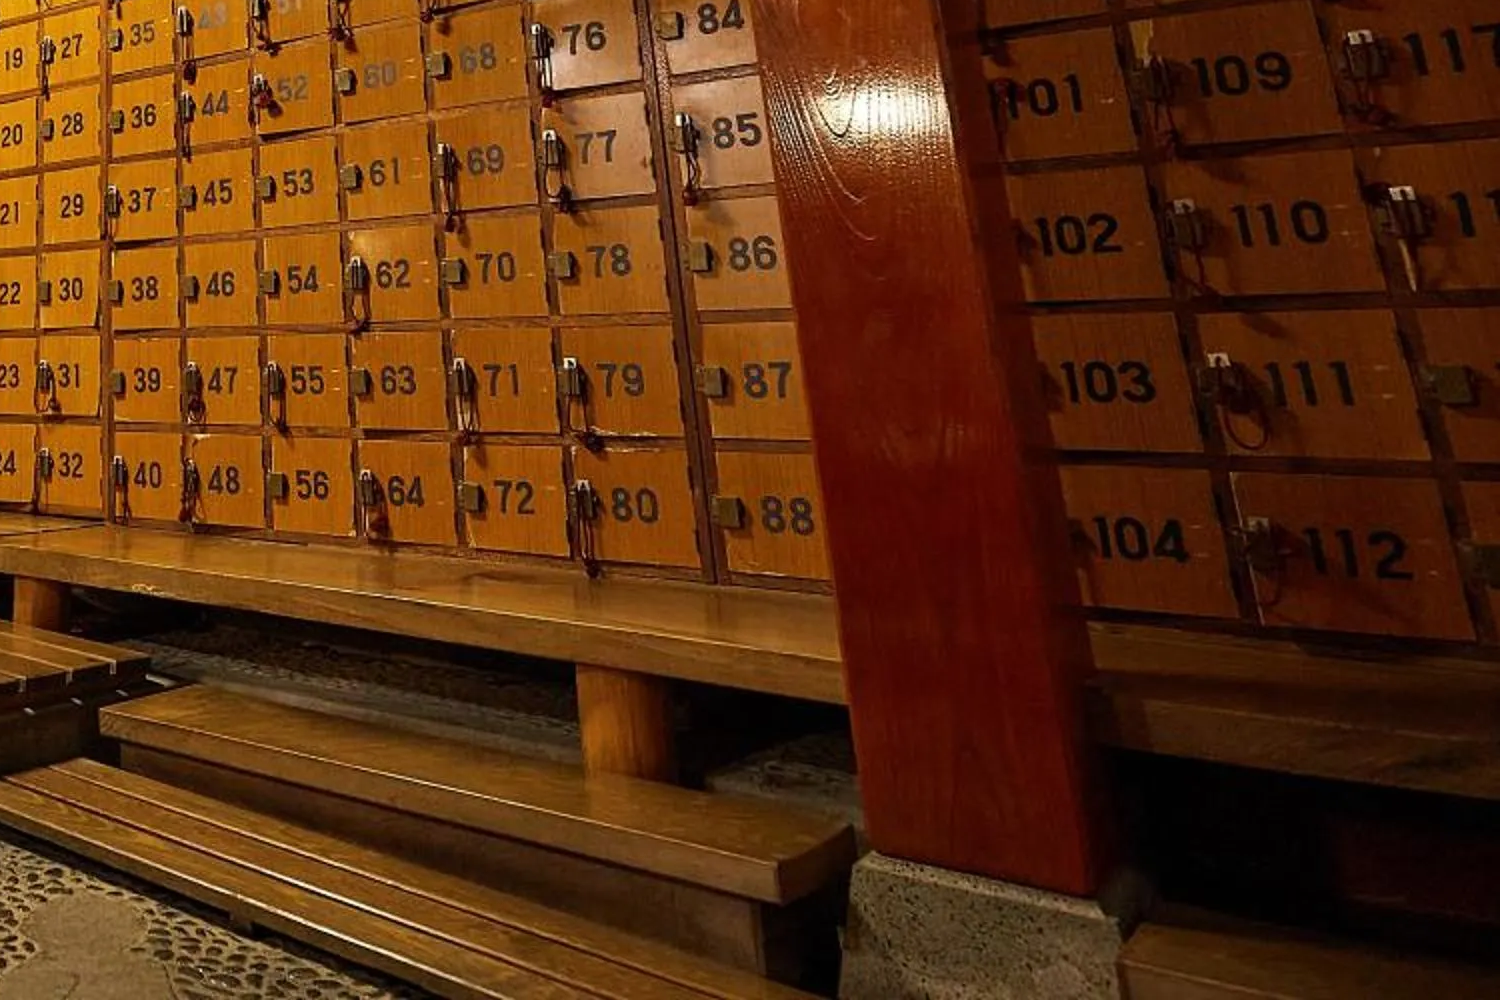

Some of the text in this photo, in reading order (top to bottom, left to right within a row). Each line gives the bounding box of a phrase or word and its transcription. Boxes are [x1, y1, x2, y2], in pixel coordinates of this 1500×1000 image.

[60, 34, 83, 59] 27
[129, 20, 155, 45] 35
[562, 21, 607, 55] 76
[4, 49, 23, 71] 19
[458, 42, 497, 72] 68
[362, 61, 396, 88] 60
[1192, 51, 1292, 96] 109
[202, 90, 229, 116] 44
[277, 75, 308, 102] 52
[1006, 73, 1083, 119] 101
[61, 112, 84, 136] 28
[131, 104, 156, 128] 36
[712, 112, 762, 149] 85
[1, 123, 23, 148] 20
[574, 129, 618, 164] 77
[369, 157, 400, 186] 61
[467, 144, 504, 174] 69
[204, 179, 232, 205] 45
[283, 169, 314, 197] 53
[1, 202, 19, 224] 21
[61, 194, 84, 218] 29
[128, 188, 156, 212] 37
[1038, 214, 1122, 256] 102
[1230, 201, 1329, 247] 110
[476, 252, 516, 284] 70
[587, 243, 631, 278] 78
[728, 235, 778, 272] 86
[131, 275, 159, 301] 38
[206, 271, 235, 297] 46
[288, 265, 319, 293] 54
[376, 259, 411, 288] 62
[59, 278, 83, 301] 30
[58, 365, 81, 388] 31
[134, 367, 161, 393] 39
[208, 367, 238, 394] 47
[291, 365, 324, 394] 55
[381, 366, 417, 395] 63
[483, 363, 519, 396] 71
[596, 362, 645, 397] 79
[743, 361, 792, 399] 87
[1061, 361, 1156, 403] 103
[1265, 361, 1356, 407] 111
[58, 452, 83, 478] 32
[134, 462, 162, 488] 40
[208, 465, 240, 493] 48
[296, 470, 329, 500] 56
[388, 476, 424, 507] 64
[494, 480, 535, 514] 72
[611, 487, 659, 524] 80
[761, 496, 814, 535] 88
[1094, 517, 1189, 563] 104
[1305, 528, 1413, 581] 112
